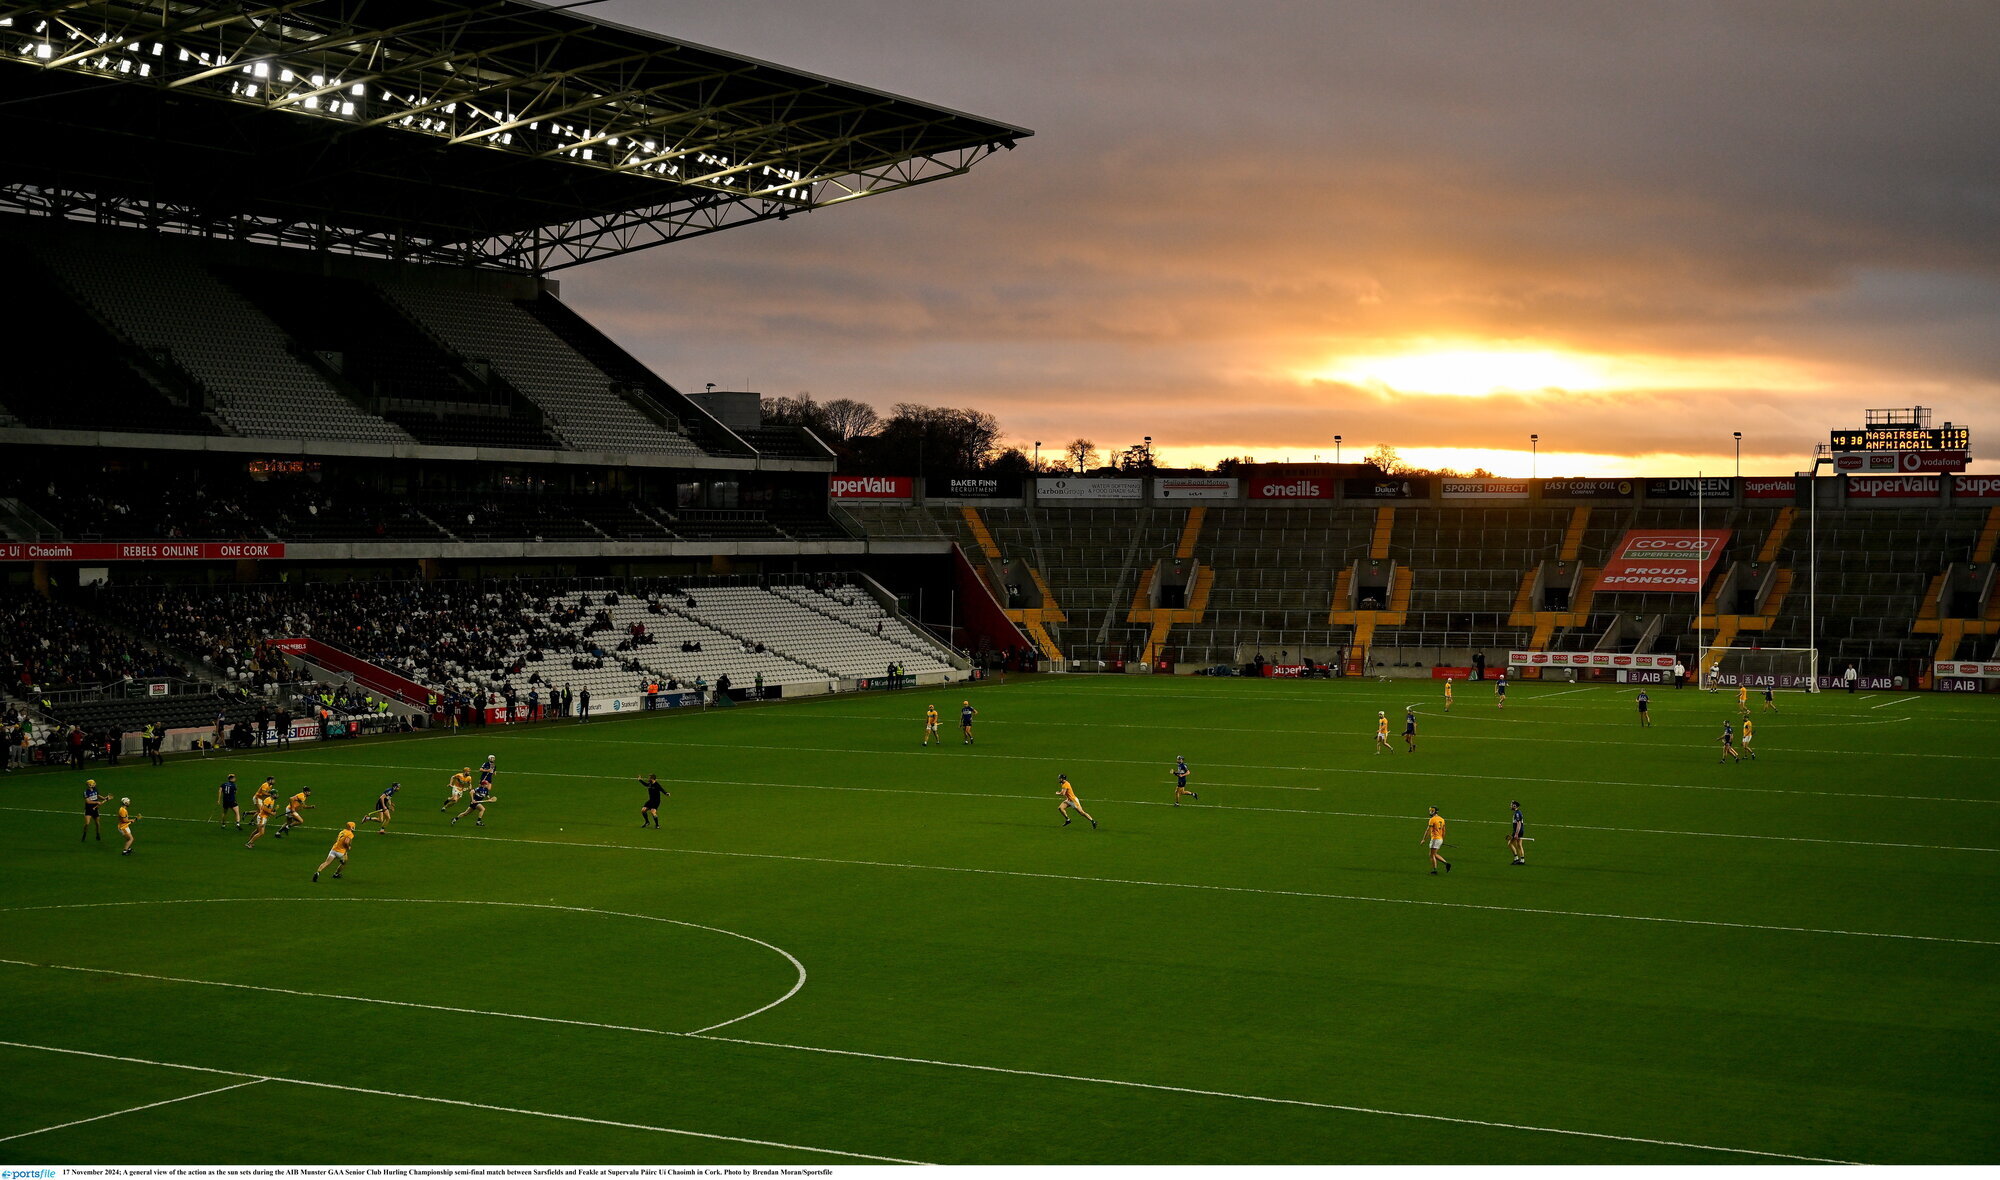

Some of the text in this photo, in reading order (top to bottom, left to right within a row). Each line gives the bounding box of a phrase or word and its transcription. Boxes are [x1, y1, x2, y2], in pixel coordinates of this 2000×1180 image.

[1866, 431, 1967, 440] NASAIRSEAL 1:18
[1866, 440, 1967, 449] ANFHIACAIL 1:17
[1922, 457, 1961, 467] vodafone
[831, 477, 896, 497] uperValu
[951, 479, 997, 487] BAKER FINN
[1545, 481, 1616, 490] EAST CORK OIL
[1669, 479, 1730, 491] DINEEN
[1745, 481, 1796, 493] SuperValu
[1848, 477, 1940, 497] SuperValu
[1444, 484, 1526, 493] SPORTS DIRECT
[29, 545, 73, 557] Chaoimh
[123, 546, 199, 557] REBELS ONLINE
[220, 545, 269, 556] ONE CORK
[1603, 577, 1699, 585] SPONSORS
[1641, 673, 1661, 682] AIB
[1718, 675, 1737, 685] AIB
[1755, 676, 1775, 686] AIB
[1870, 678, 1892, 688] AIB
[1954, 680, 1976, 691] AIB
